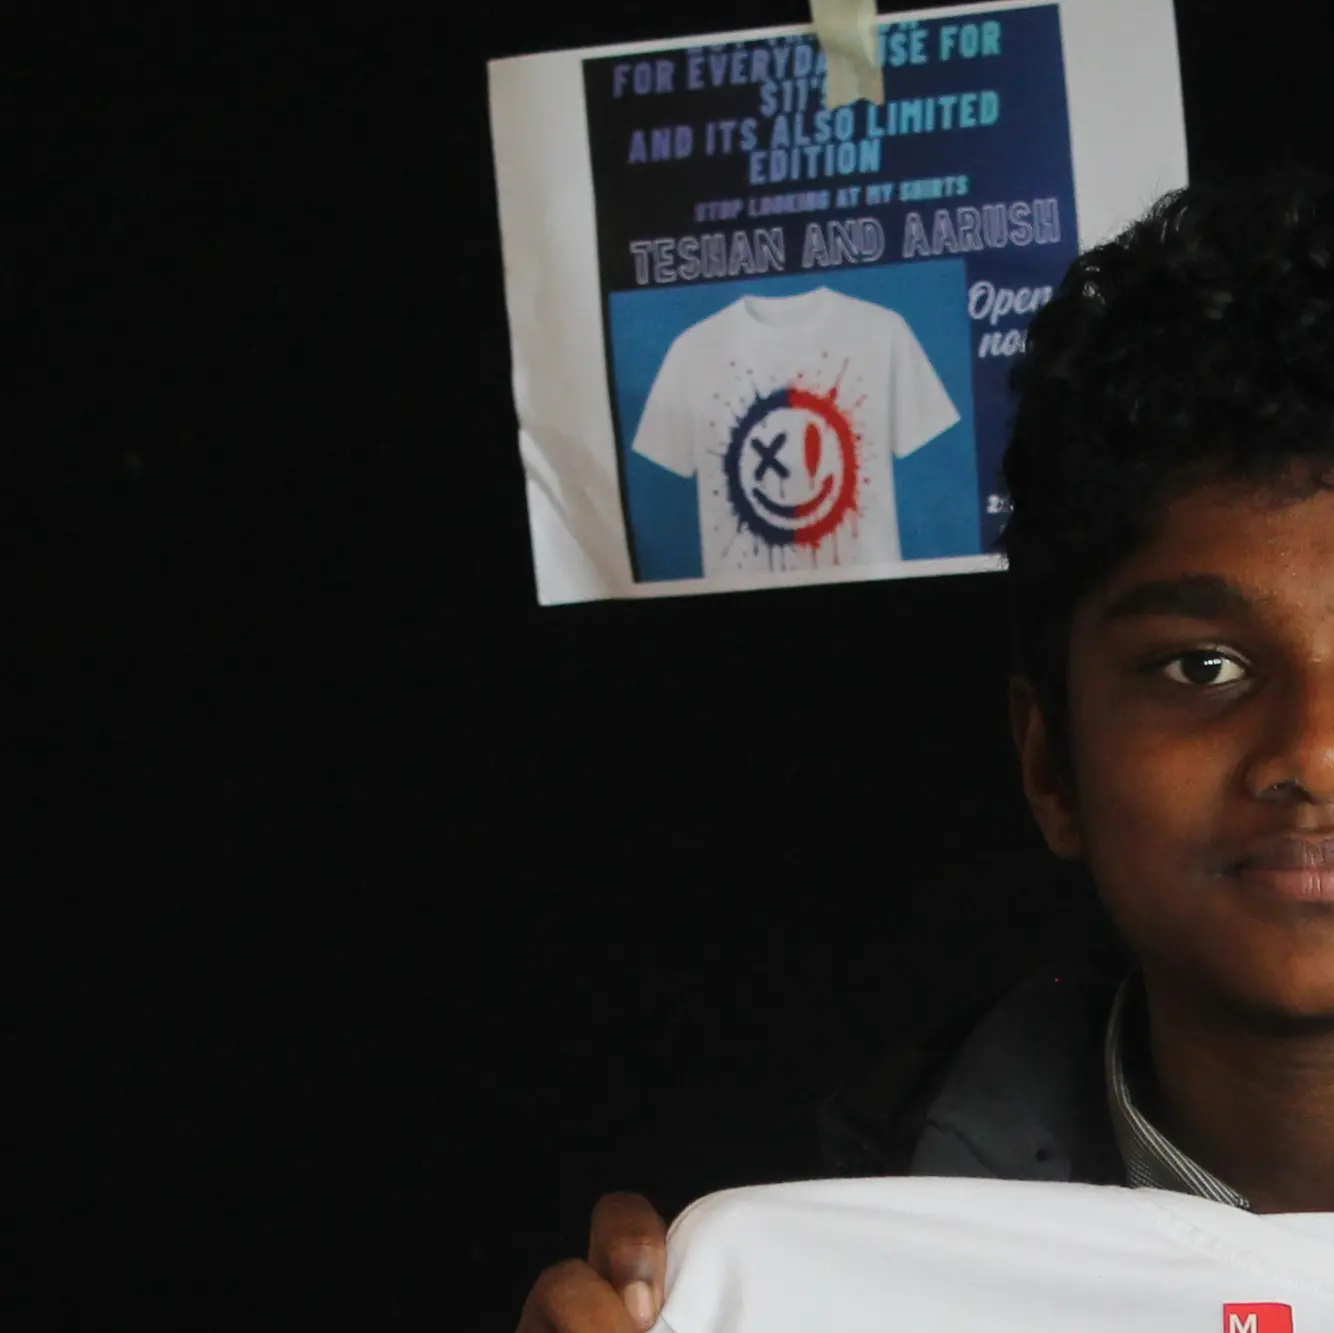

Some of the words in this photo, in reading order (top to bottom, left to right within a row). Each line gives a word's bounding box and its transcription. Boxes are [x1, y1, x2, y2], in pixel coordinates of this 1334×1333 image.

[613, 59, 676, 98] FOR
[686, 43, 827, 90] EVERYD
[939, 20, 1001, 61] FOR
[628, 126, 694, 164] AND
[706, 118, 758, 155] ITS
[771, 108, 855, 149] ALSO
[867, 91, 1000, 138] LIMITED
[748, 139, 882, 185] EDITION
[694, 201, 743, 222] STOP
[748, 191, 828, 218] LOOKING
[835, 186, 863, 208] AT
[867, 184, 895, 205] MY
[901, 175, 969, 201] SHIRTS
[629, 227, 786, 285] TESHAN
[801, 218, 886, 269] AND
[903, 198, 1061, 258] AARUSH
[968, 280, 1053, 327] Open
